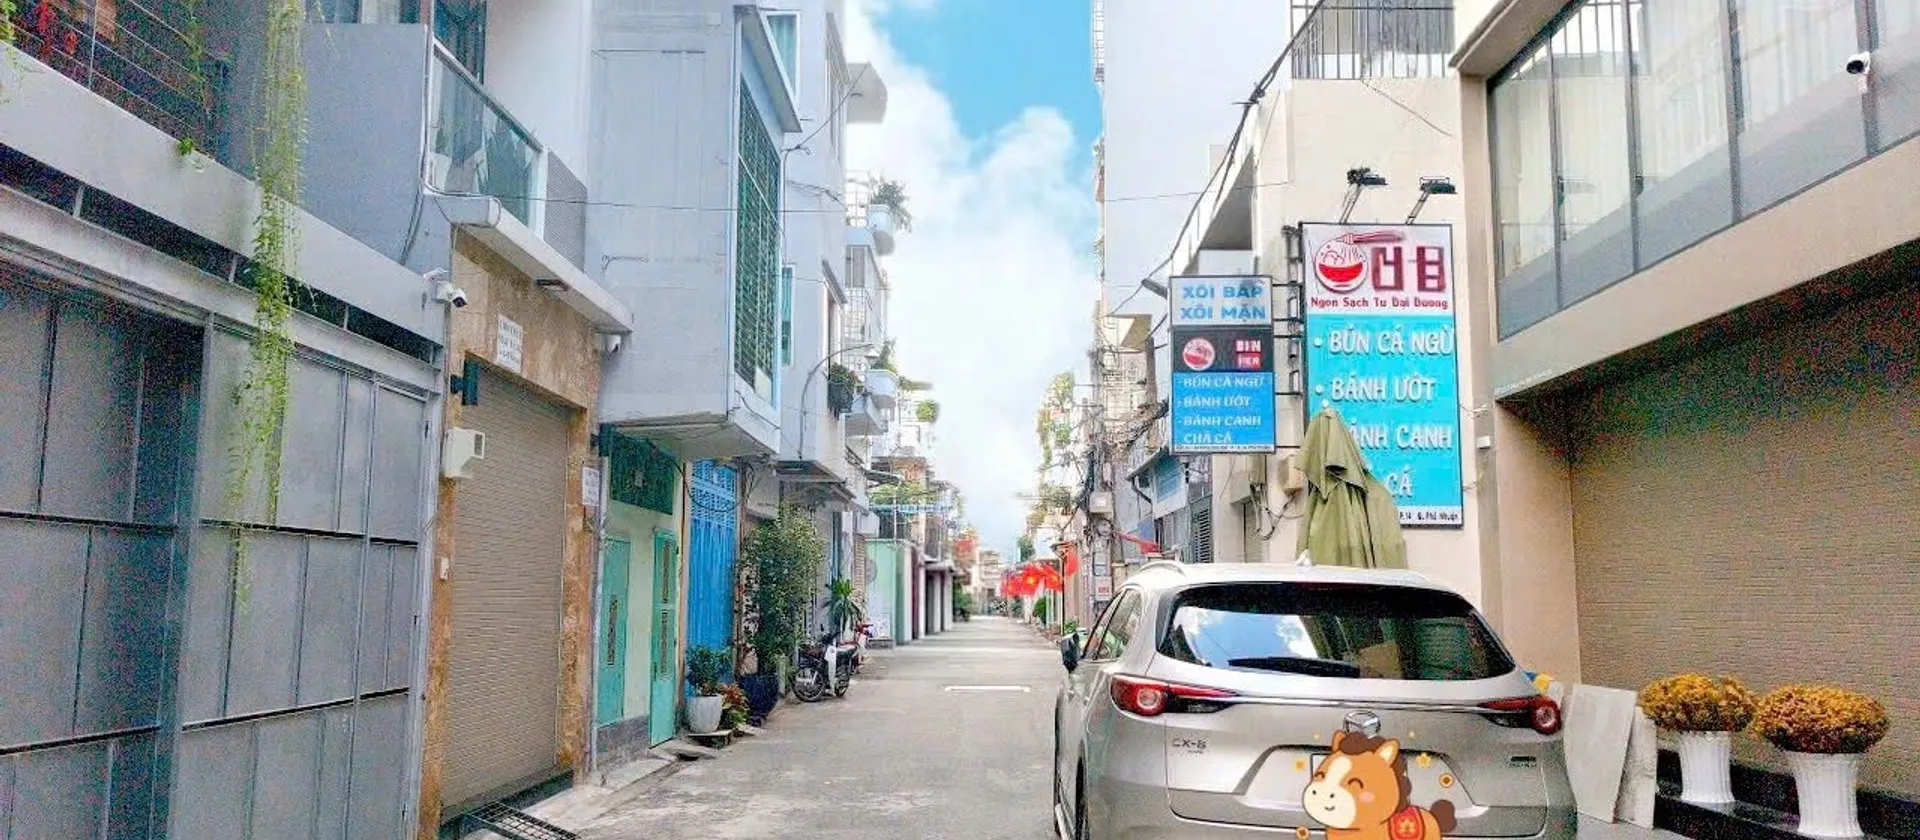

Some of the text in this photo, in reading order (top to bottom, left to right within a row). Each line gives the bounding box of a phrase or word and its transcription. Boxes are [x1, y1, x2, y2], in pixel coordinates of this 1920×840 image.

[1180, 302, 1266, 322] XÔI MẶN
[1329, 323, 1370, 355] BÚN
[1376, 323, 1404, 355] CÁ
[1183, 374, 1210, 388] BÚN
[1331, 371, 1387, 402] BÁNH
[1223, 414, 1262, 427] CANH
[1396, 422, 1453, 450] CANH
